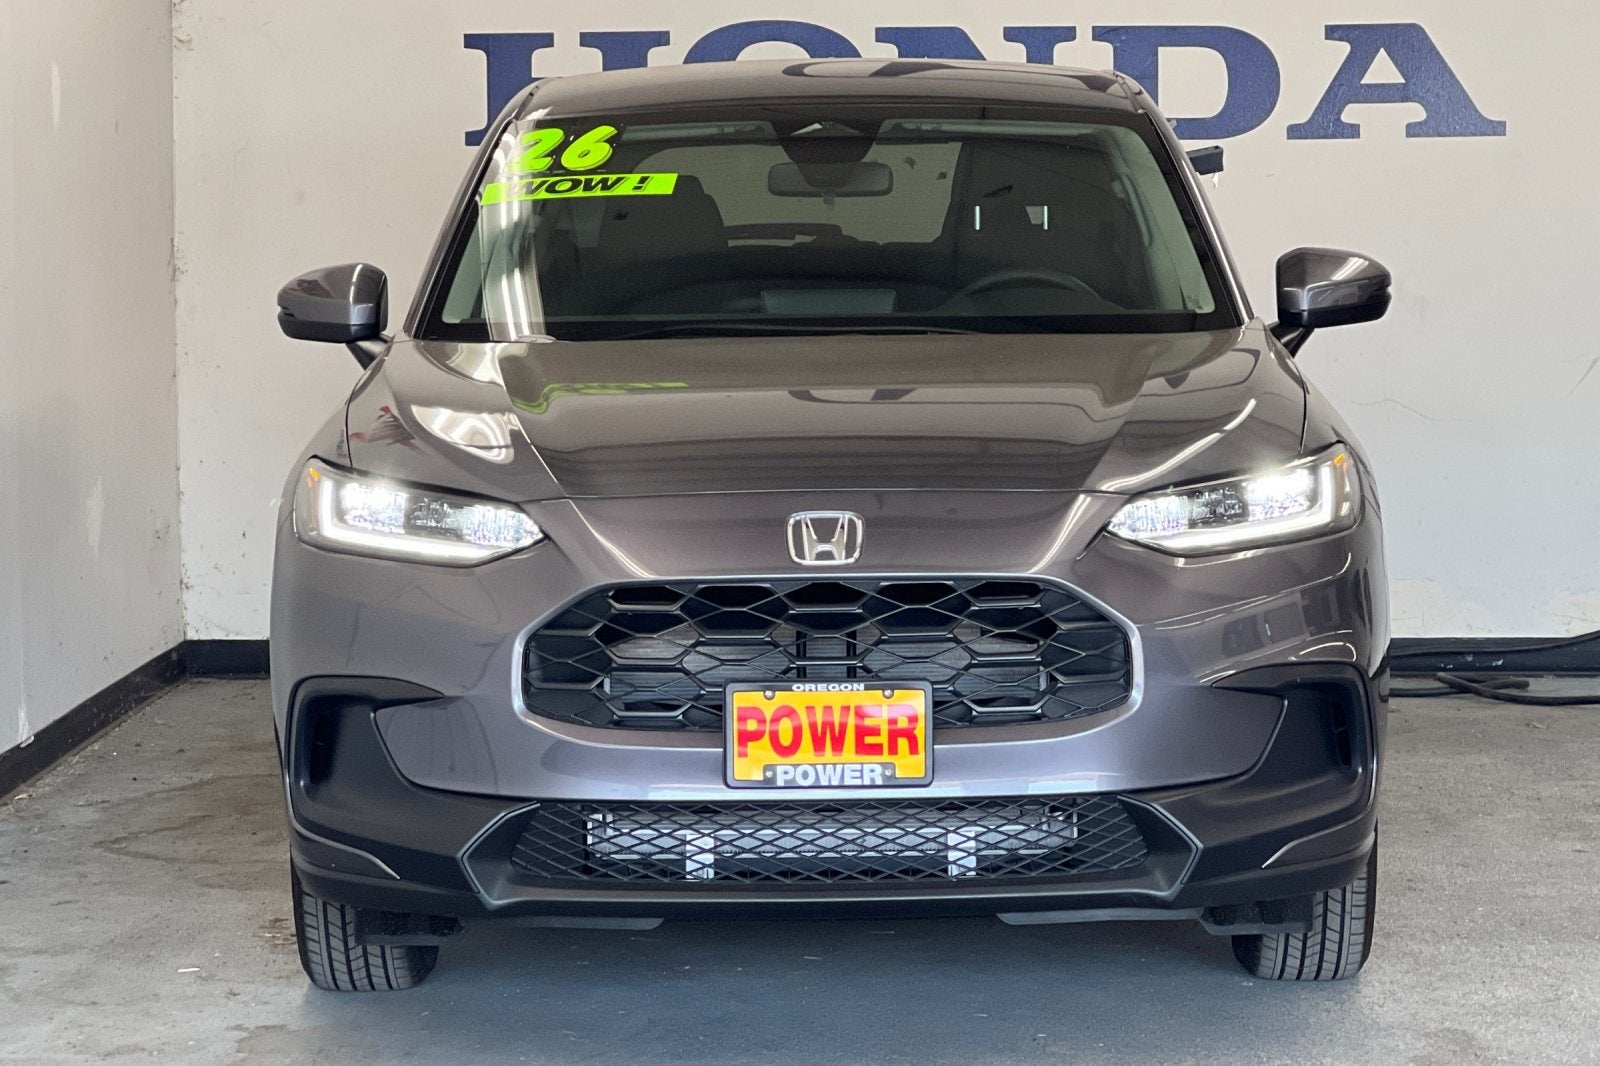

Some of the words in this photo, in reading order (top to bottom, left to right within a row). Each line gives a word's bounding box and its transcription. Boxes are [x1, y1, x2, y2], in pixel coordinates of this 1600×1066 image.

[464, 20, 1506, 147] HDA
[507, 125, 617, 171] 26
[792, 683, 865, 692] OREGON
[736, 704, 920, 758] POWER
[776, 763, 883, 786] POWER
